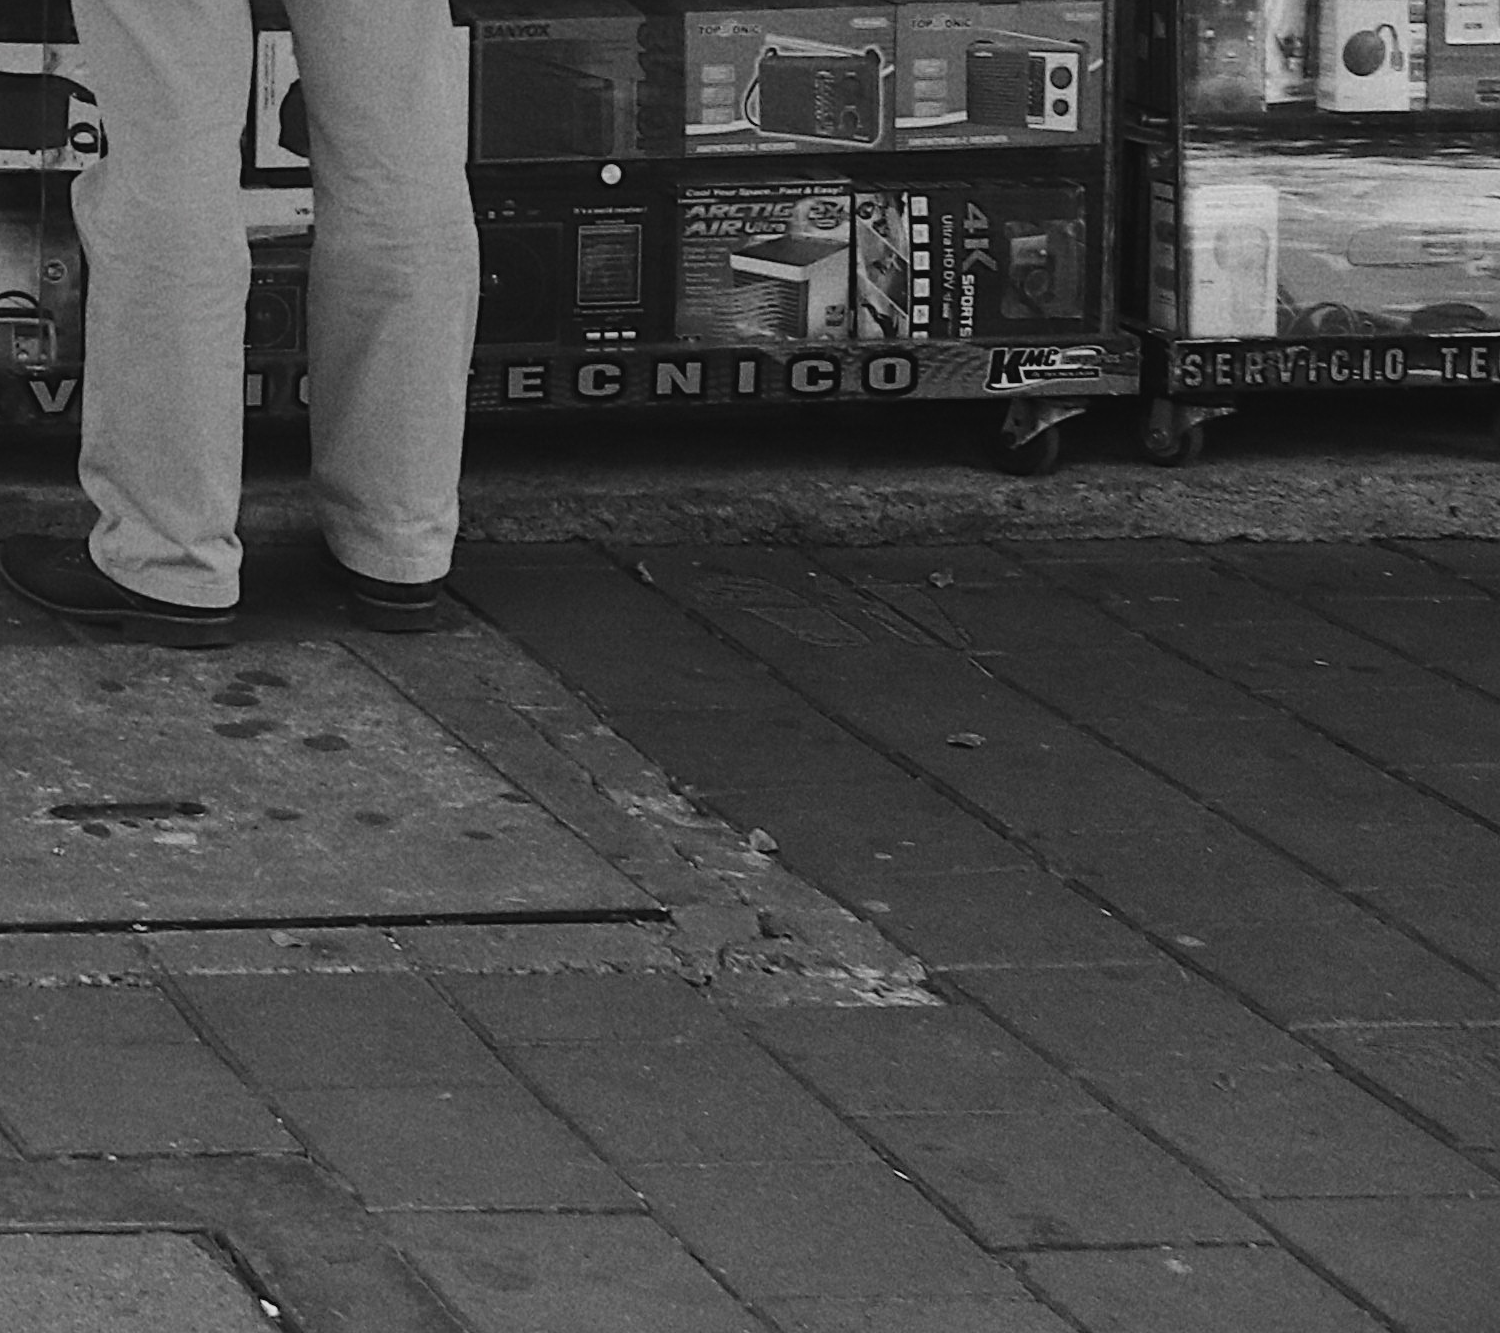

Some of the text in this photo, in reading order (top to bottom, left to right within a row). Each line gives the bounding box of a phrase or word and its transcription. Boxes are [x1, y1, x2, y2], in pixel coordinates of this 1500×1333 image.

[684, 187, 712, 199] Cool
[713, 187, 736, 198] Your
[684, 219, 745, 238] AIR
[1183, 345, 1407, 389] SERVICIO
